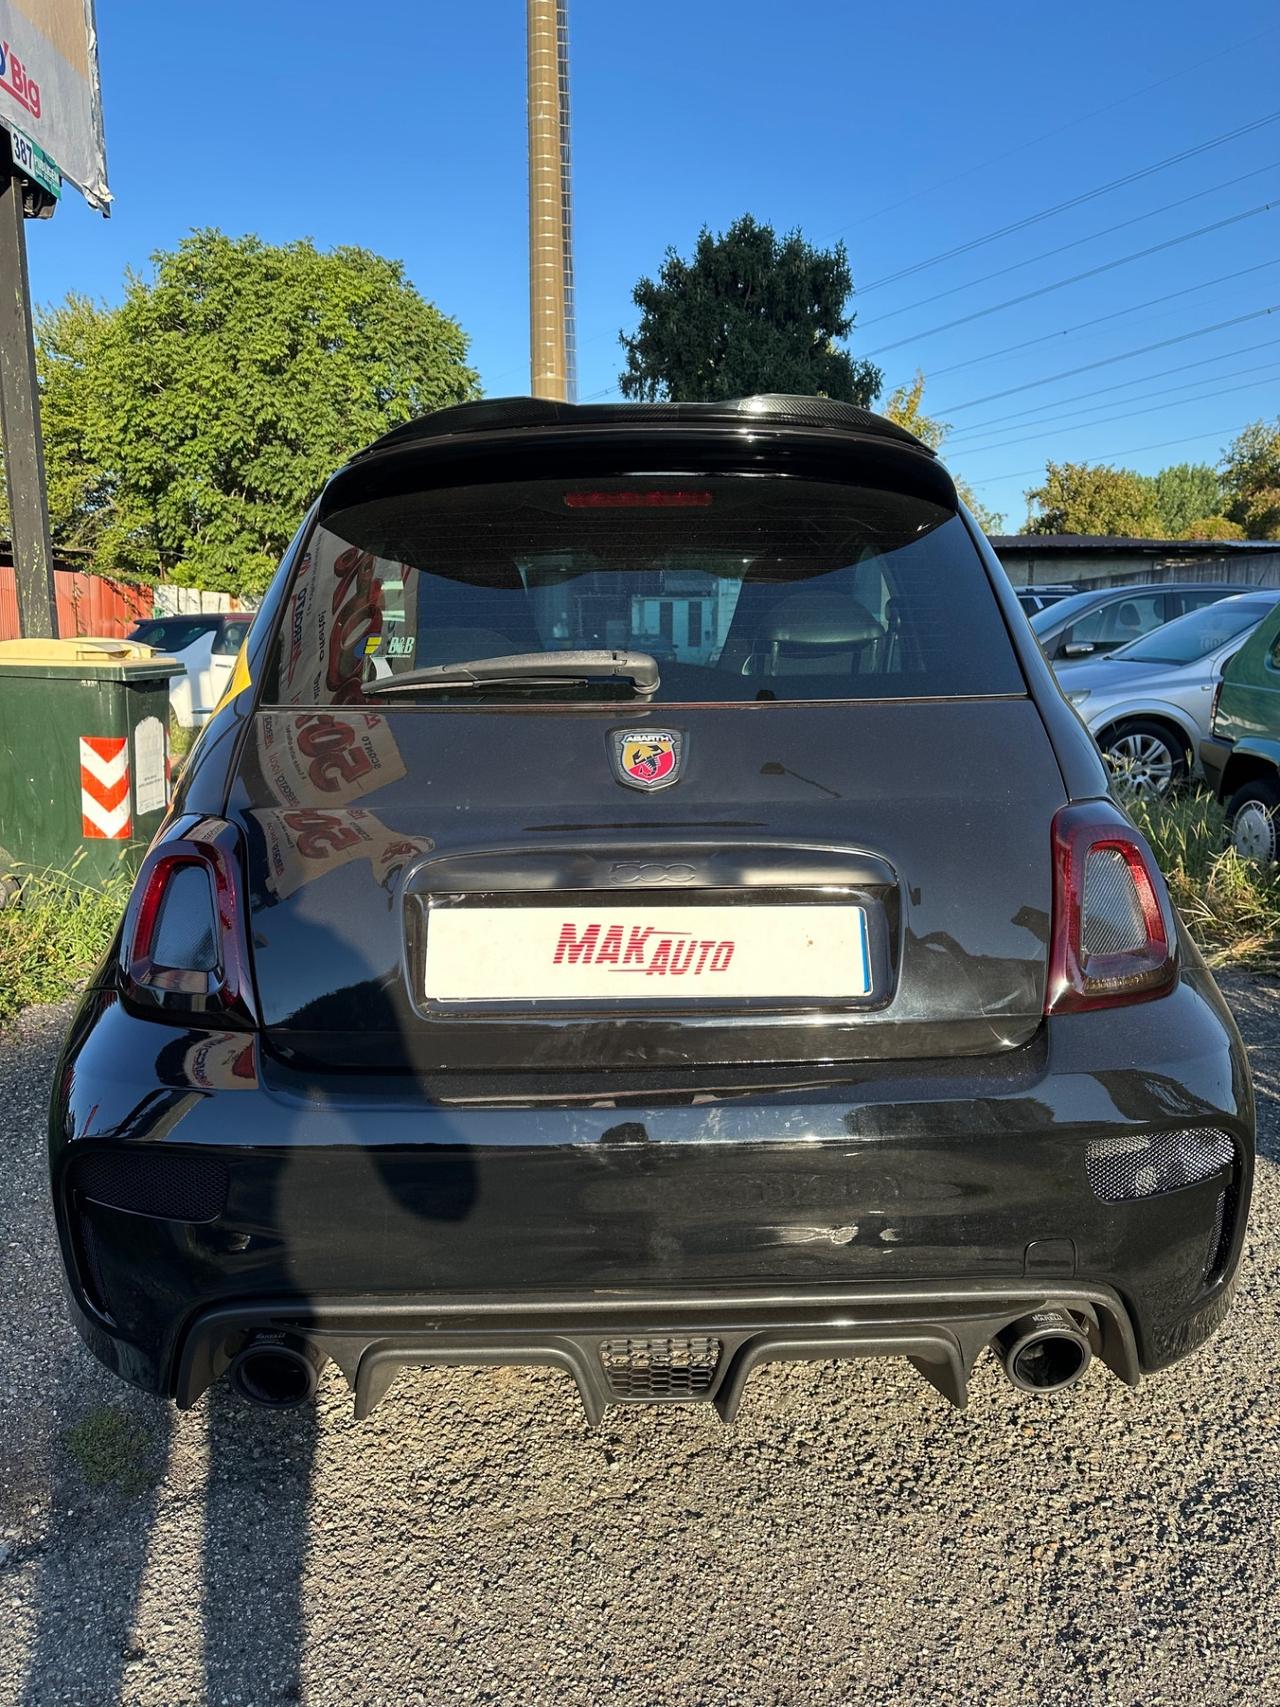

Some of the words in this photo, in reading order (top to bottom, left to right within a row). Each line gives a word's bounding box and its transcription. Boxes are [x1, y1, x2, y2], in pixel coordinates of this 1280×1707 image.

[13, 133, 32, 170] 387
[388, 636, 415, 654] B&B
[608, 861, 696, 883] 500
[553, 923, 655, 964] MAK
[646, 939, 735, 975] AUTO
